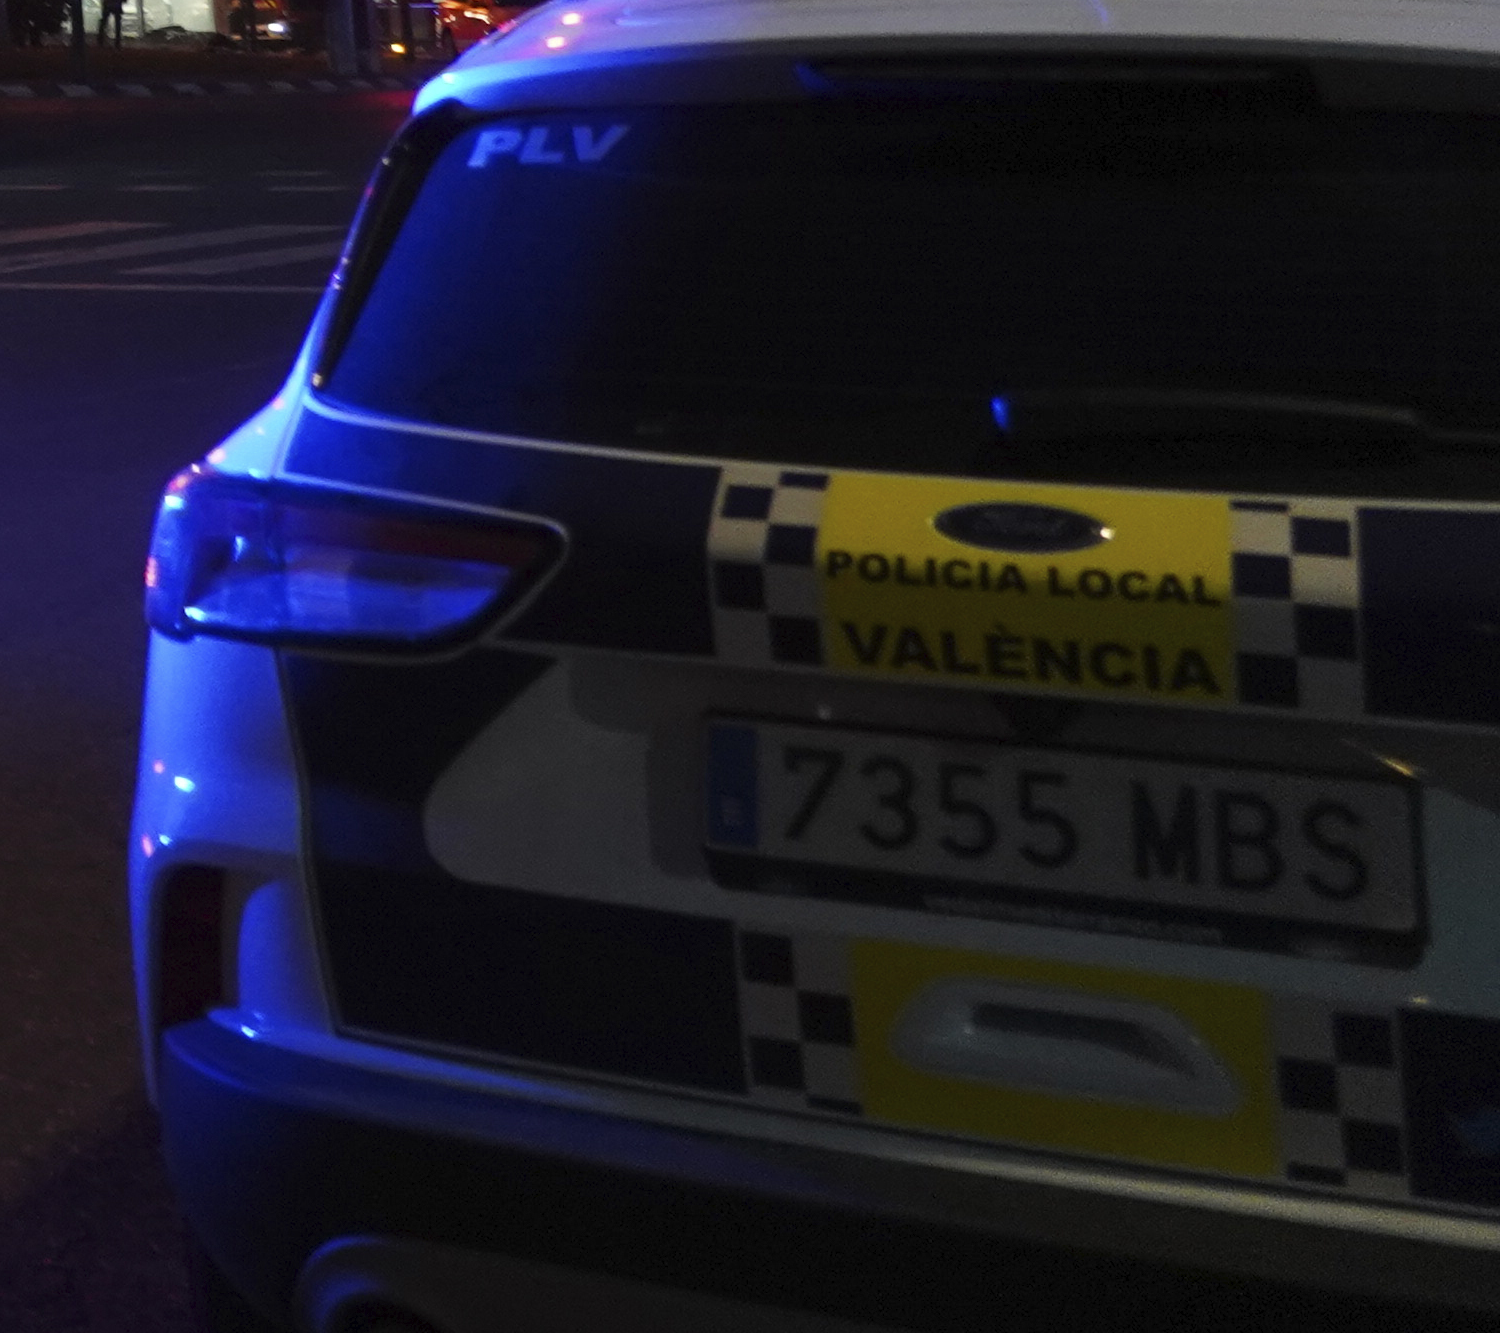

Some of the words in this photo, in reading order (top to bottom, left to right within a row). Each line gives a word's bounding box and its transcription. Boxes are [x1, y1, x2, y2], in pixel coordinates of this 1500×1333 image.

[467, 123, 632, 169] PLV
[826, 549, 1028, 592] POLICIA
[1047, 565, 1222, 607] LOCAL
[840, 619, 1223, 695] VALÈNCIA
[782, 744, 1078, 871] 7355
[1130, 778, 1370, 903] MBS
